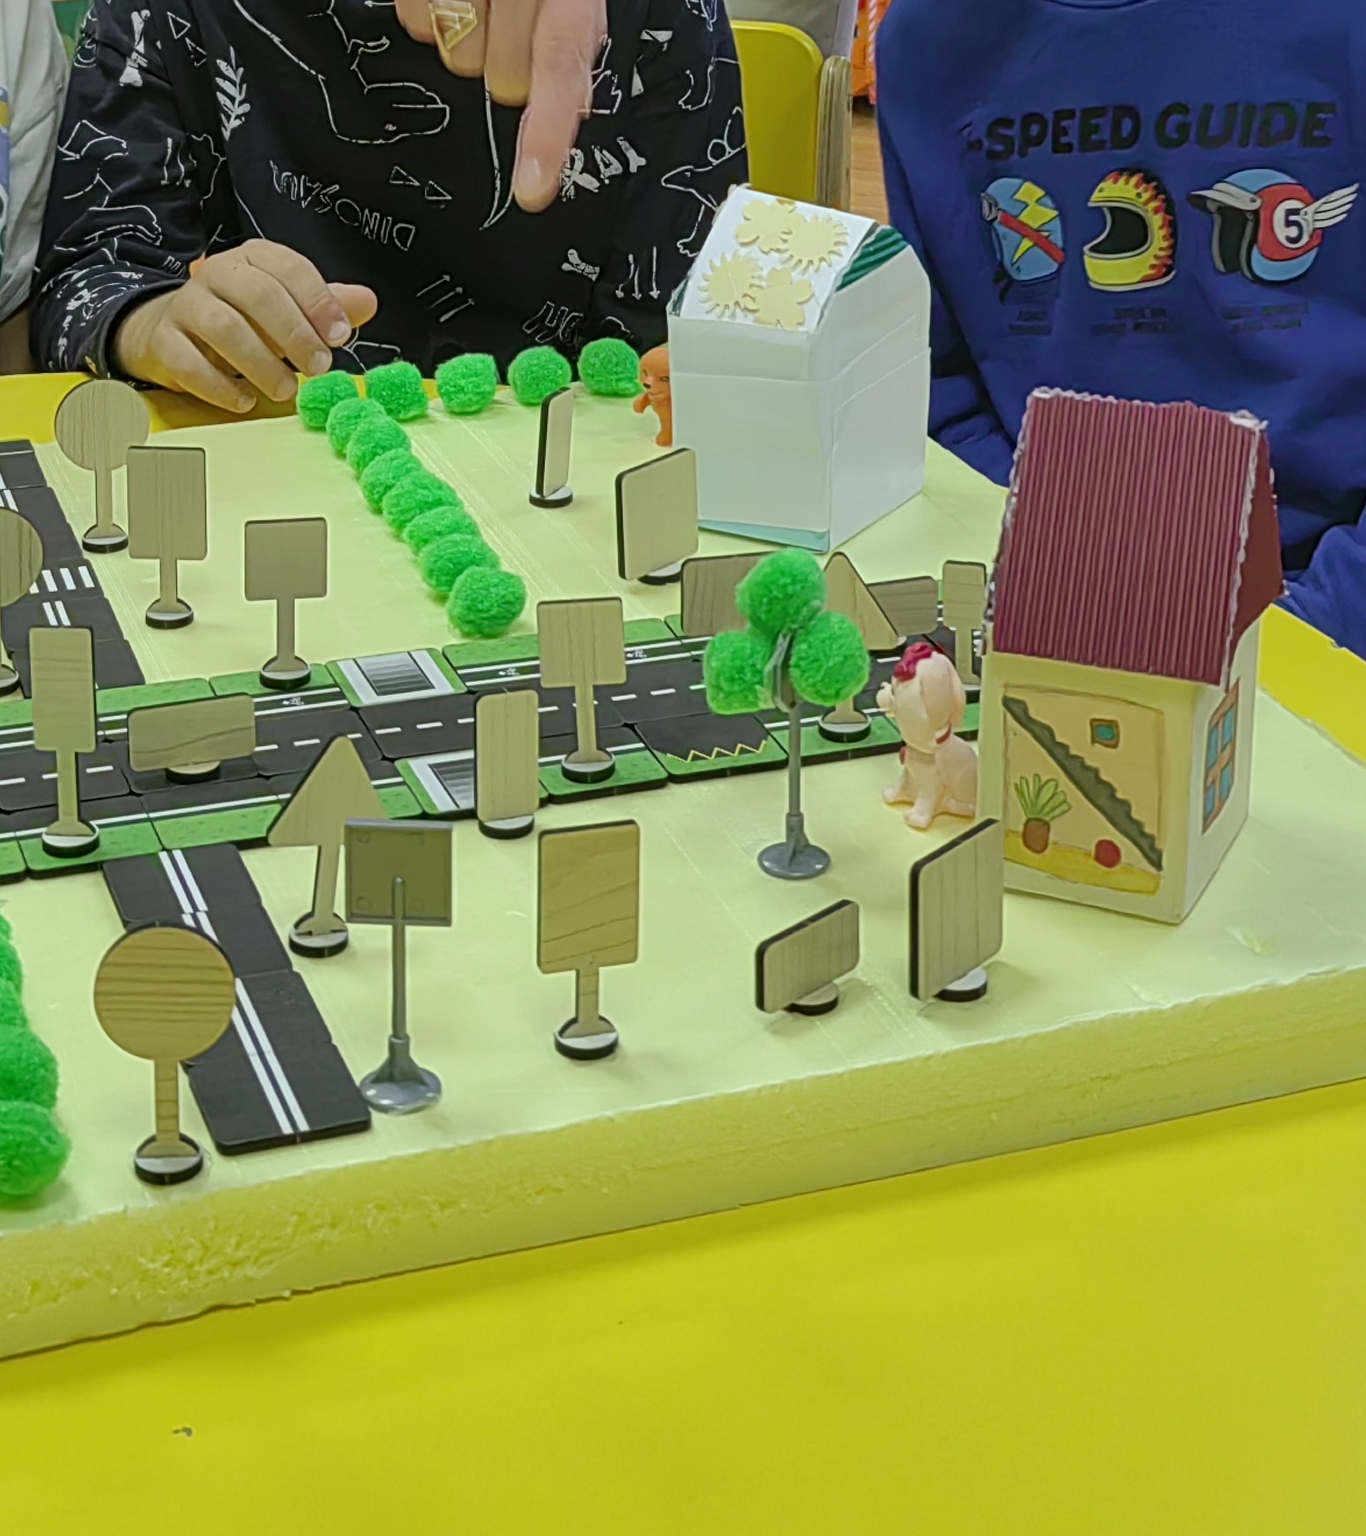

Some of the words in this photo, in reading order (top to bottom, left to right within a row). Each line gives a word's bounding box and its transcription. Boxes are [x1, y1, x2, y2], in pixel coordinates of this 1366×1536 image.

[985, 103, 1141, 162] SPEED
[1153, 100, 1336, 150] GUIDE
[1284, 207, 1305, 245] 5
